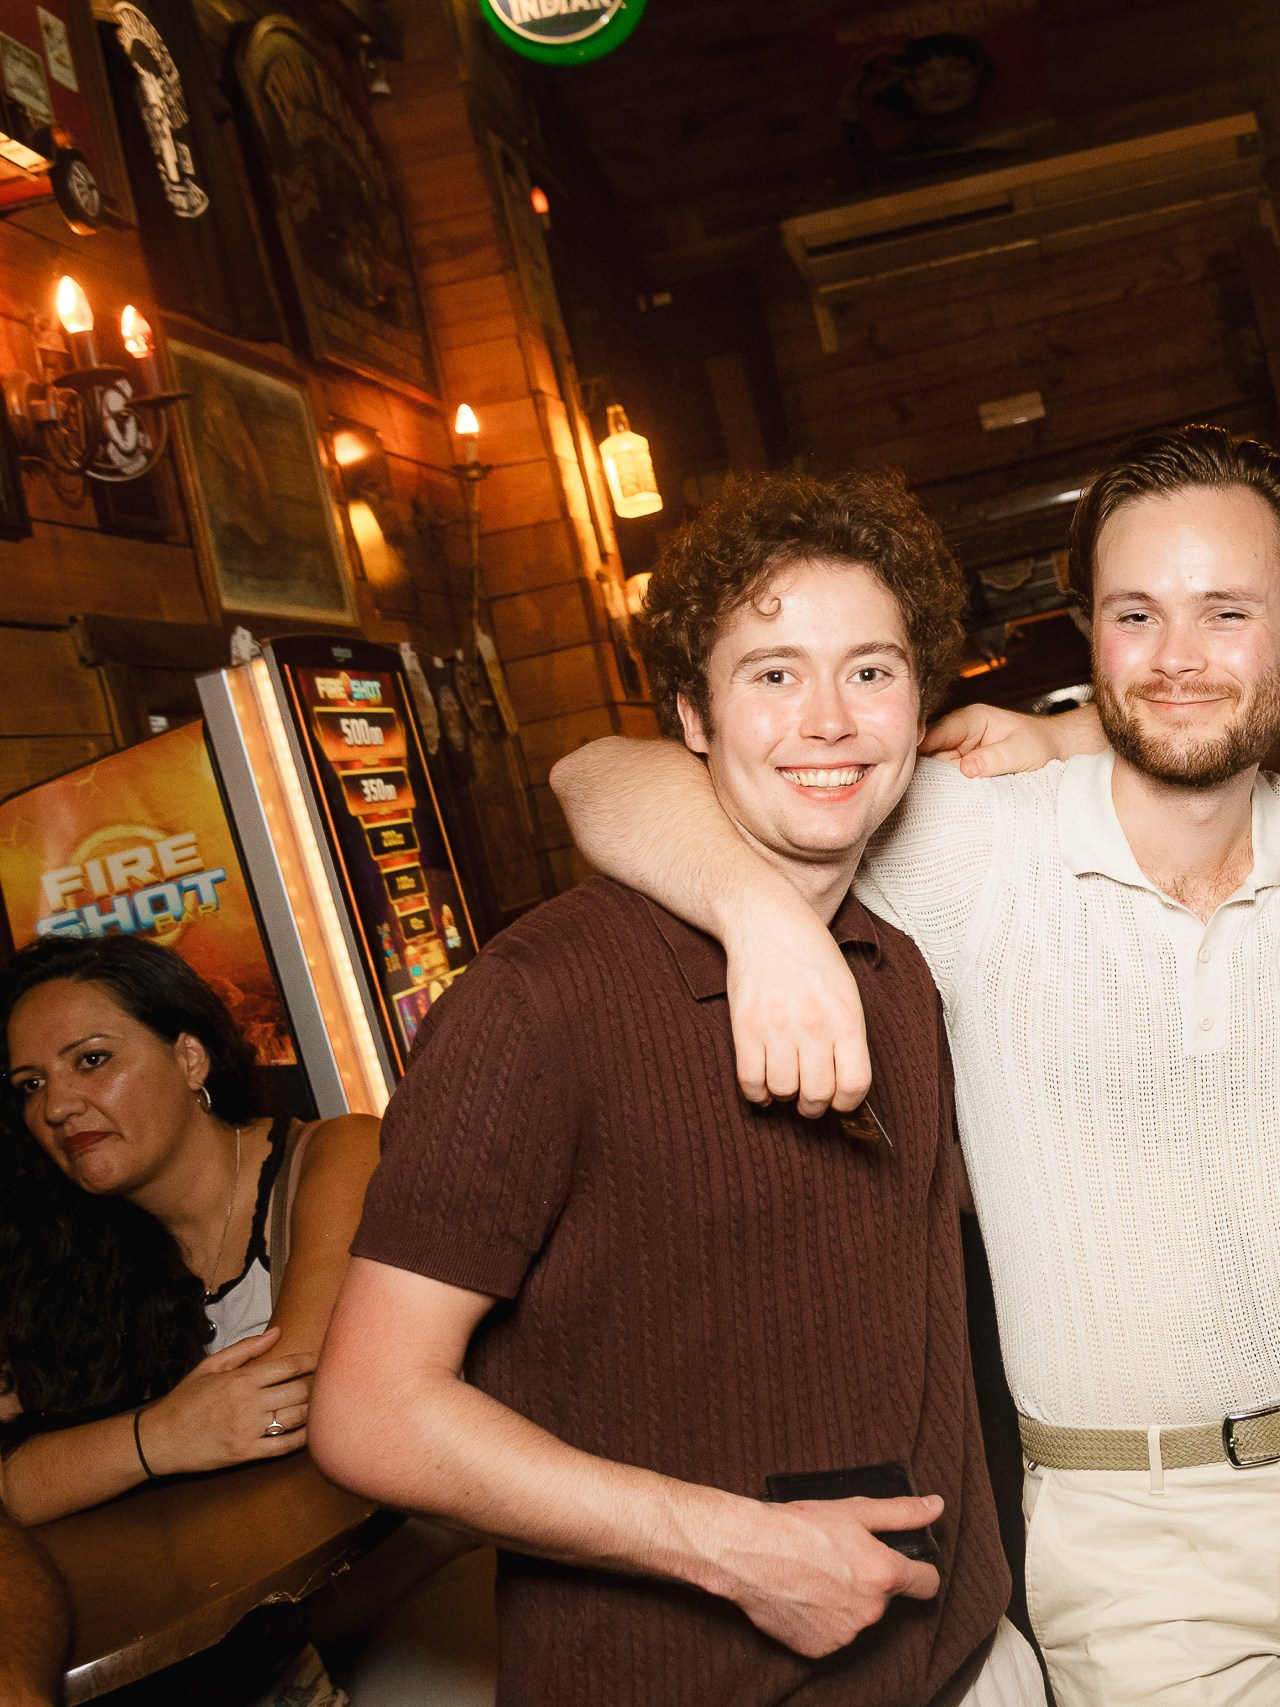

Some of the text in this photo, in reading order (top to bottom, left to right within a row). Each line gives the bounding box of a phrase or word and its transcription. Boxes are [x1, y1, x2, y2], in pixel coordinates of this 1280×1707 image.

[315, 676, 348, 699] FIRE
[349, 679, 382, 700] SHOT
[35, 868, 227, 938] SHOT
[40, 832, 205, 914] FIRE
